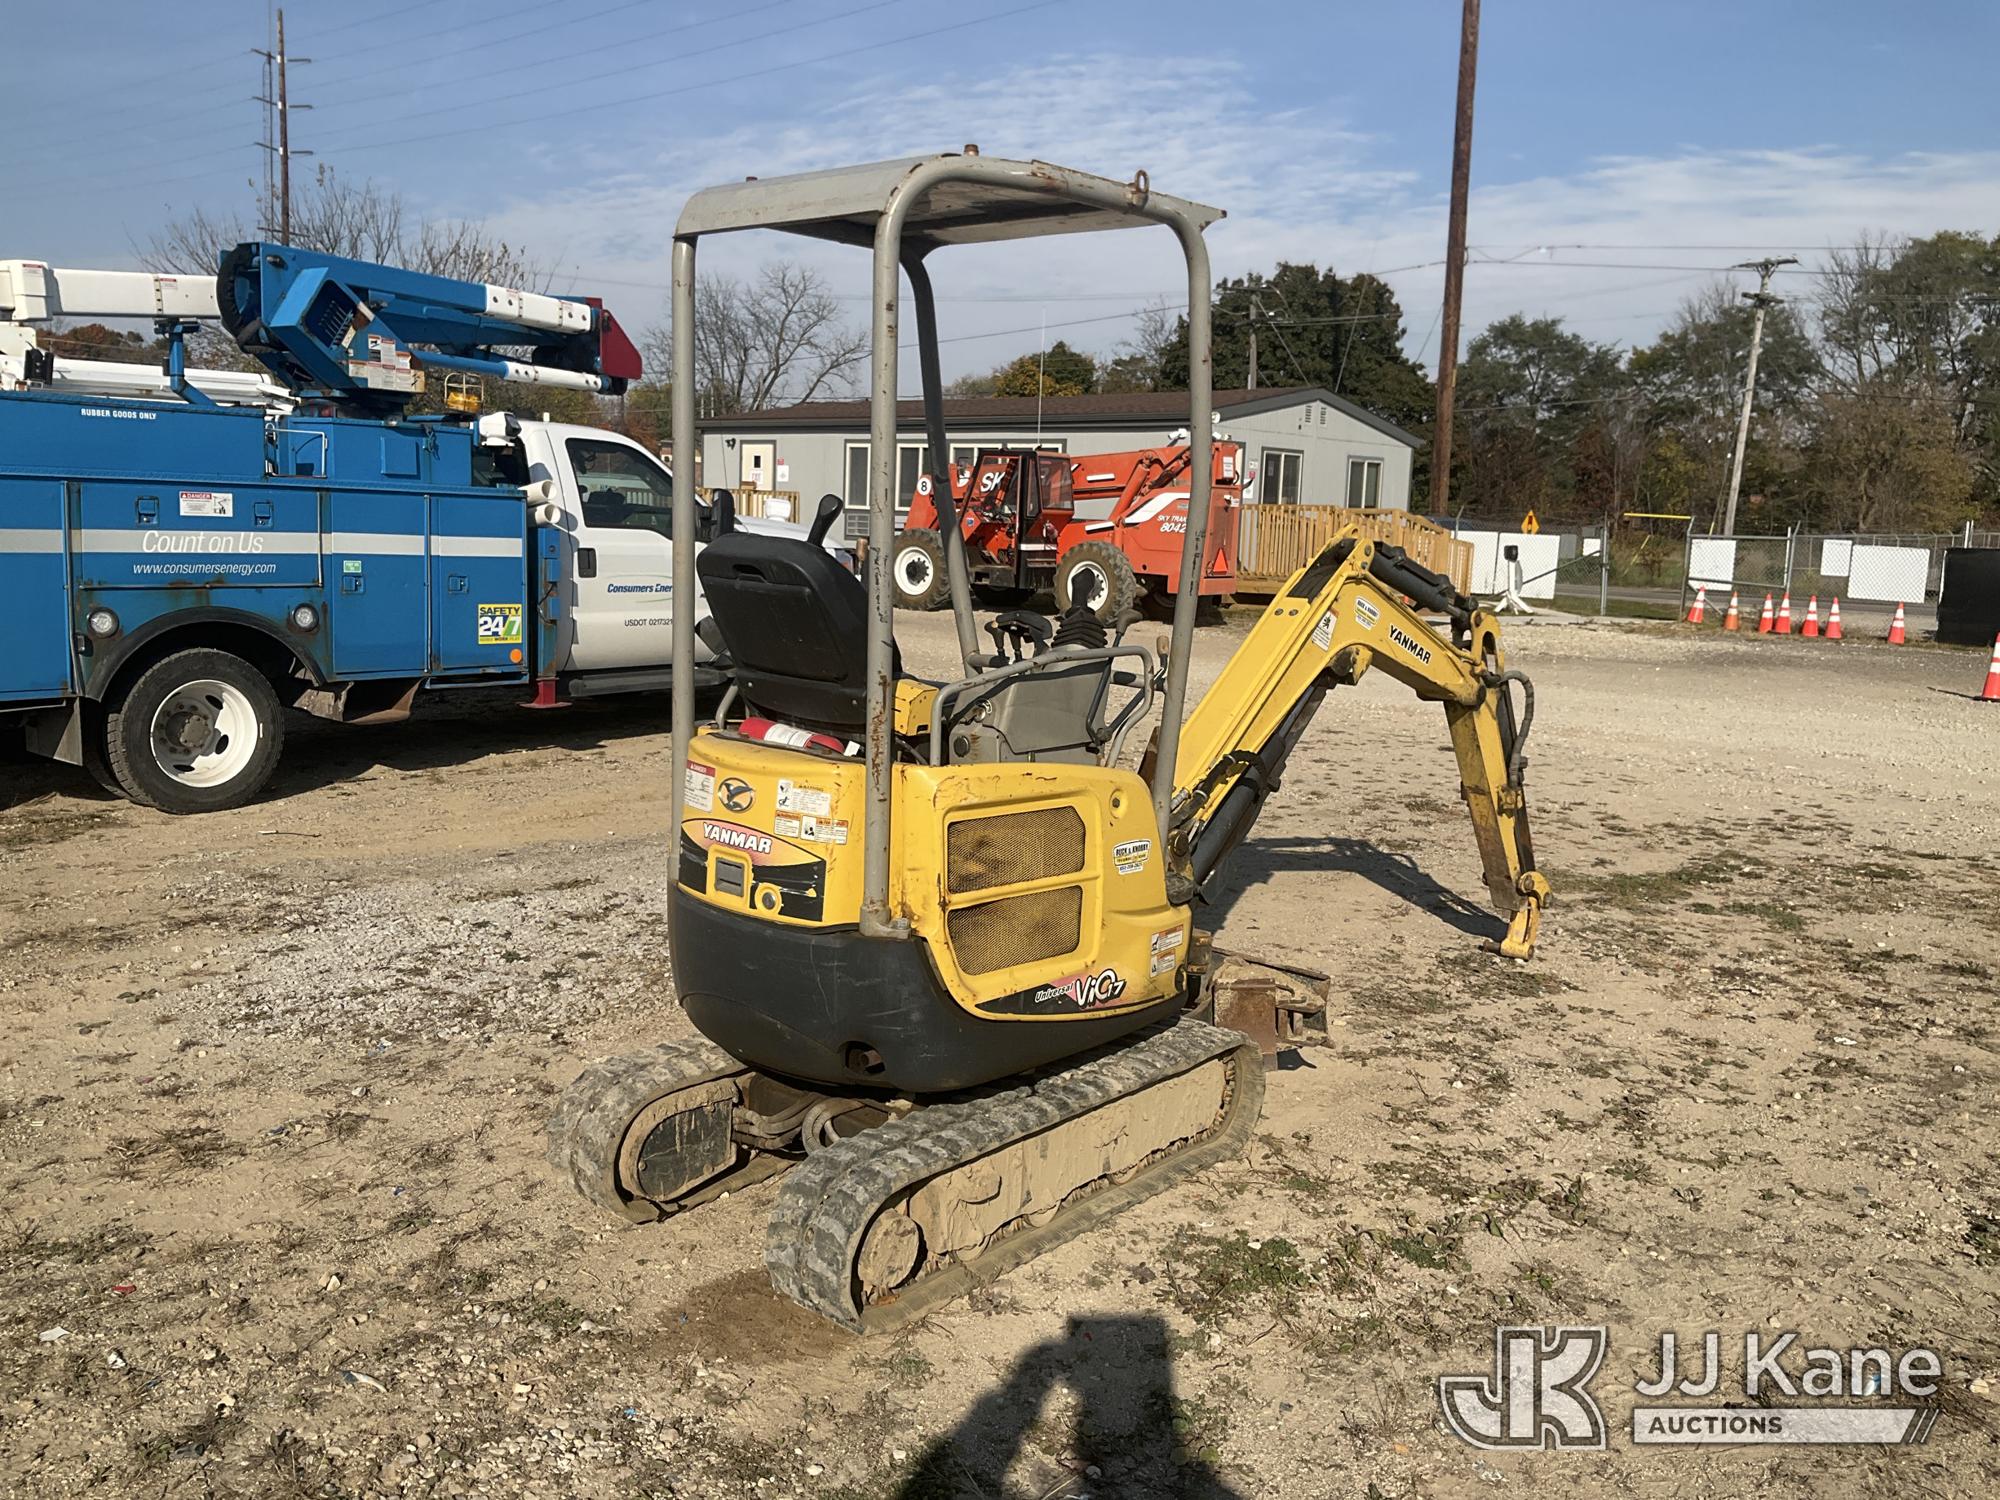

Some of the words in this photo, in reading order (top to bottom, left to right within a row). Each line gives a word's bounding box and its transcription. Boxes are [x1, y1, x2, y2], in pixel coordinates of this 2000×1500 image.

[81, 408, 110, 417] RUBBER
[112, 410, 137, 418] GOODS
[1160, 522, 1187, 533] 8042
[142, 530, 205, 552] Count
[208, 535, 233, 552] on
[239, 532, 264, 553] Us
[133, 563, 276, 576] www.consumersenergy.com
[607, 583, 654, 593] Consumers
[654, 584, 672, 592] Ener
[480, 607, 520, 615] SAFETY
[1390, 624, 1430, 664] YANMAR
[703, 822, 772, 854] YANMAR
[1035, 982, 1074, 1002] Universal
